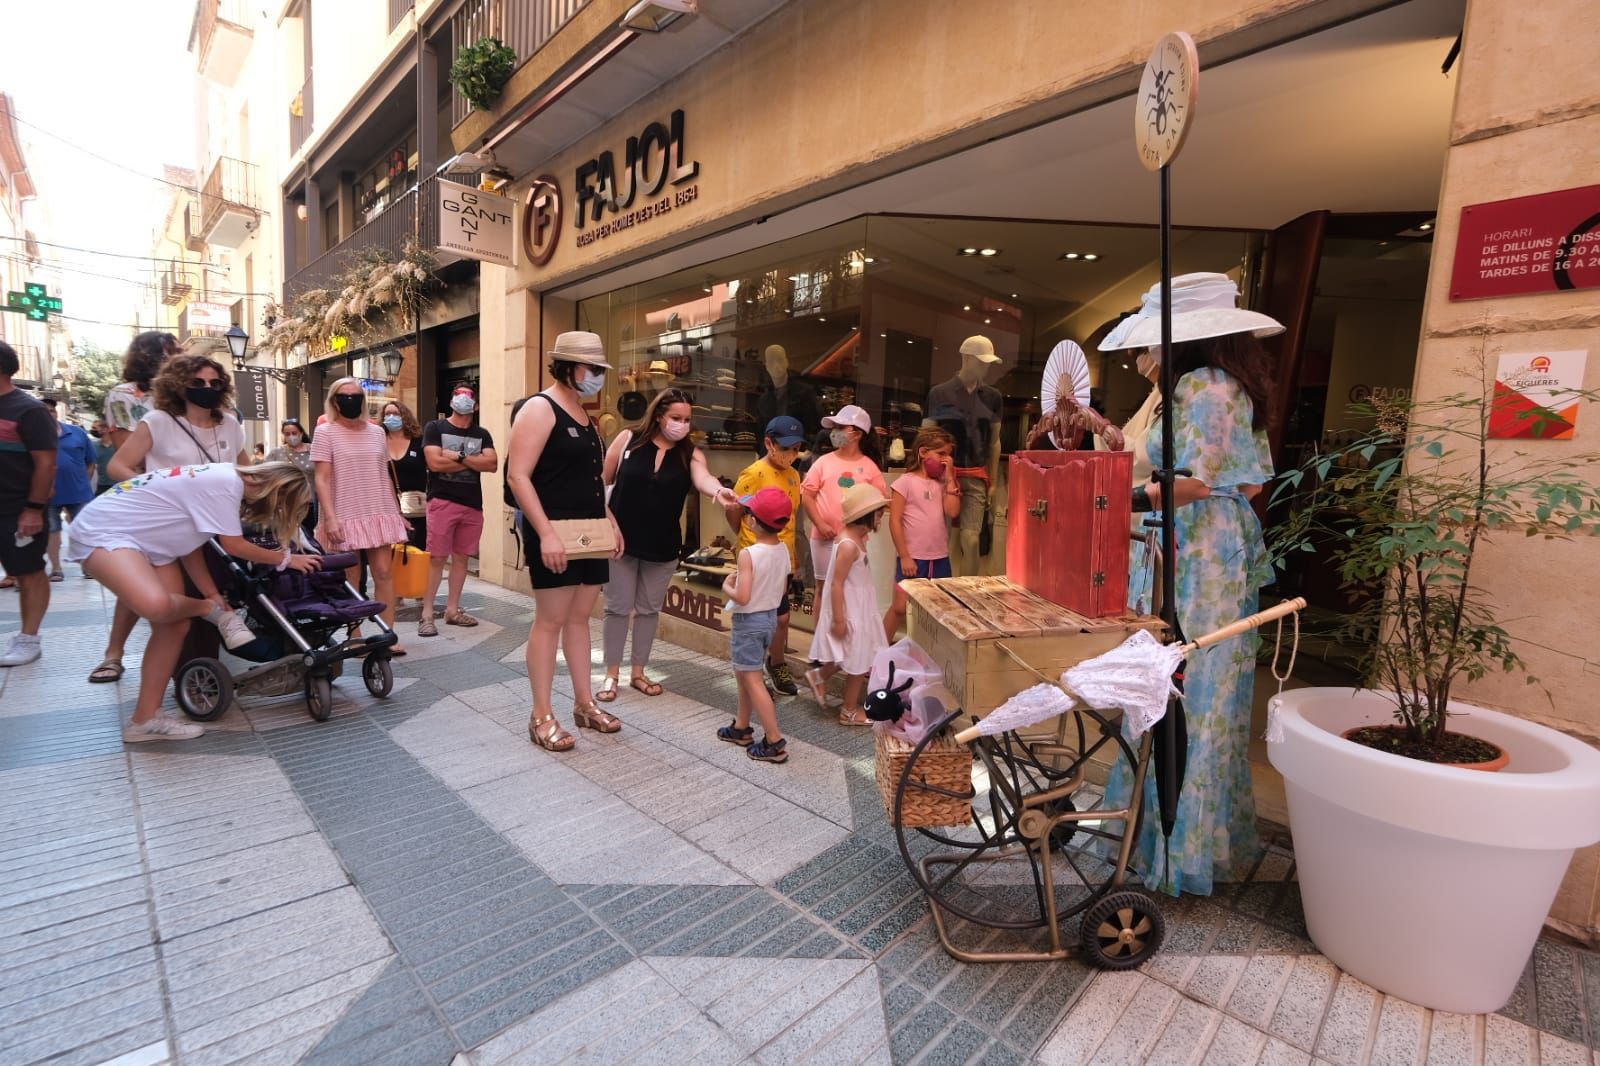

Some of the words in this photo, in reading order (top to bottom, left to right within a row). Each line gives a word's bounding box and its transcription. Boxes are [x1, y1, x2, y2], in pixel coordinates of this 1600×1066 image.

[574, 108, 700, 229] FAJOL
[443, 199, 512, 225] GANT
[596, 223, 611, 239] PER
[611, 211, 635, 233] HOME
[635, 205, 653, 223] DES
[654, 197, 672, 216] DEL
[674, 185, 699, 207] 1864
[1482, 245, 1498, 255] DE
[1503, 238, 1553, 253] DILLUNS
[1558, 235, 1567, 245] A
[1484, 228, 1532, 242] HORARI
[1480, 253, 1529, 267] MATINS
[1533, 250, 1551, 261] DE
[1555, 246, 1587, 258] 9.30
[1480, 265, 1528, 279] TARDES
[1532, 263, 1550, 273] DE
[1554, 260, 1572, 271] 16
[1575, 258, 1584, 268] A
[252, 373, 263, 384] it
[1516, 379, 1560, 387] FIGUERES
[255, 385, 265, 419] name
[663, 584, 724, 626] OME
